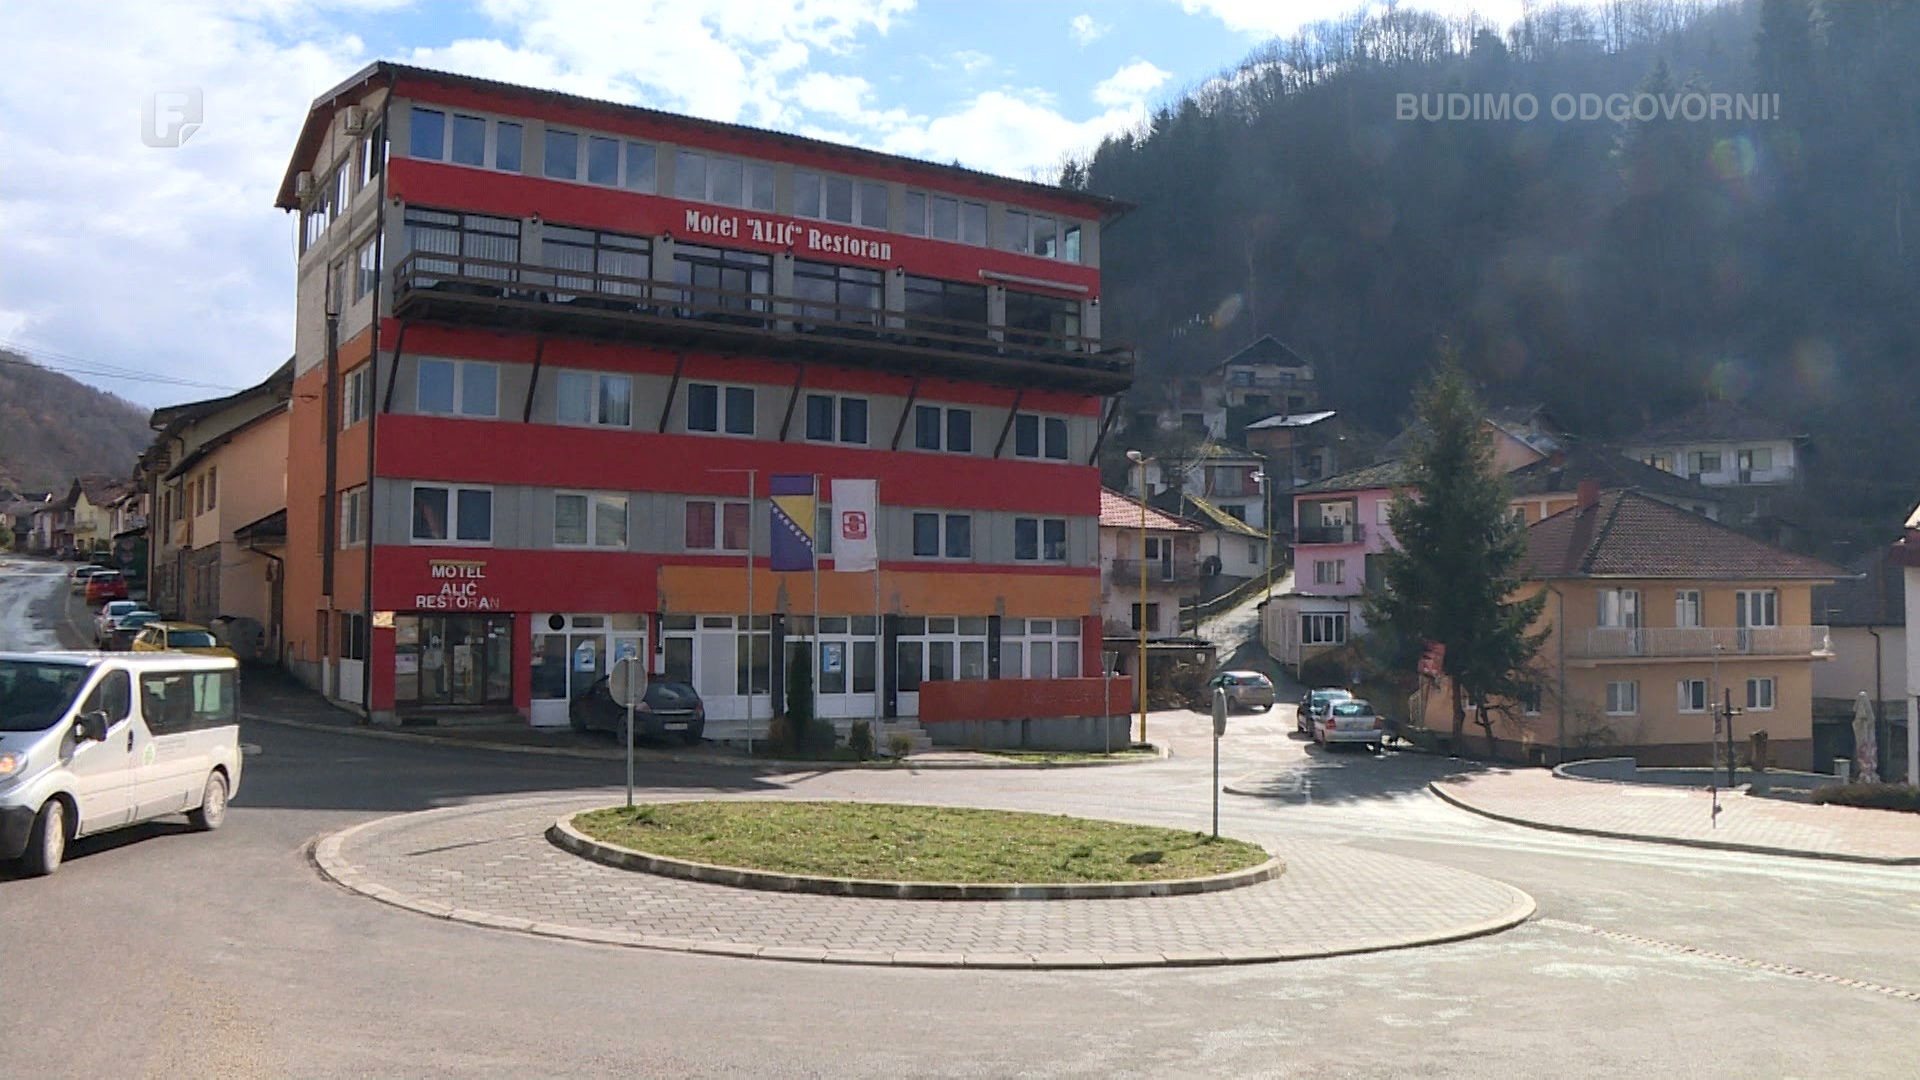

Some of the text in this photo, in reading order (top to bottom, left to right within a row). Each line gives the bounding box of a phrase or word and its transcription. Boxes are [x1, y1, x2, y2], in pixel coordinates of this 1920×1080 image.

[685, 209, 892, 261] Motel "ALIĆ" Restoran
[432, 565, 486, 579] MOTEL
[441, 580, 478, 596] ALIĆ
[416, 595, 499, 609] RESTORAN
